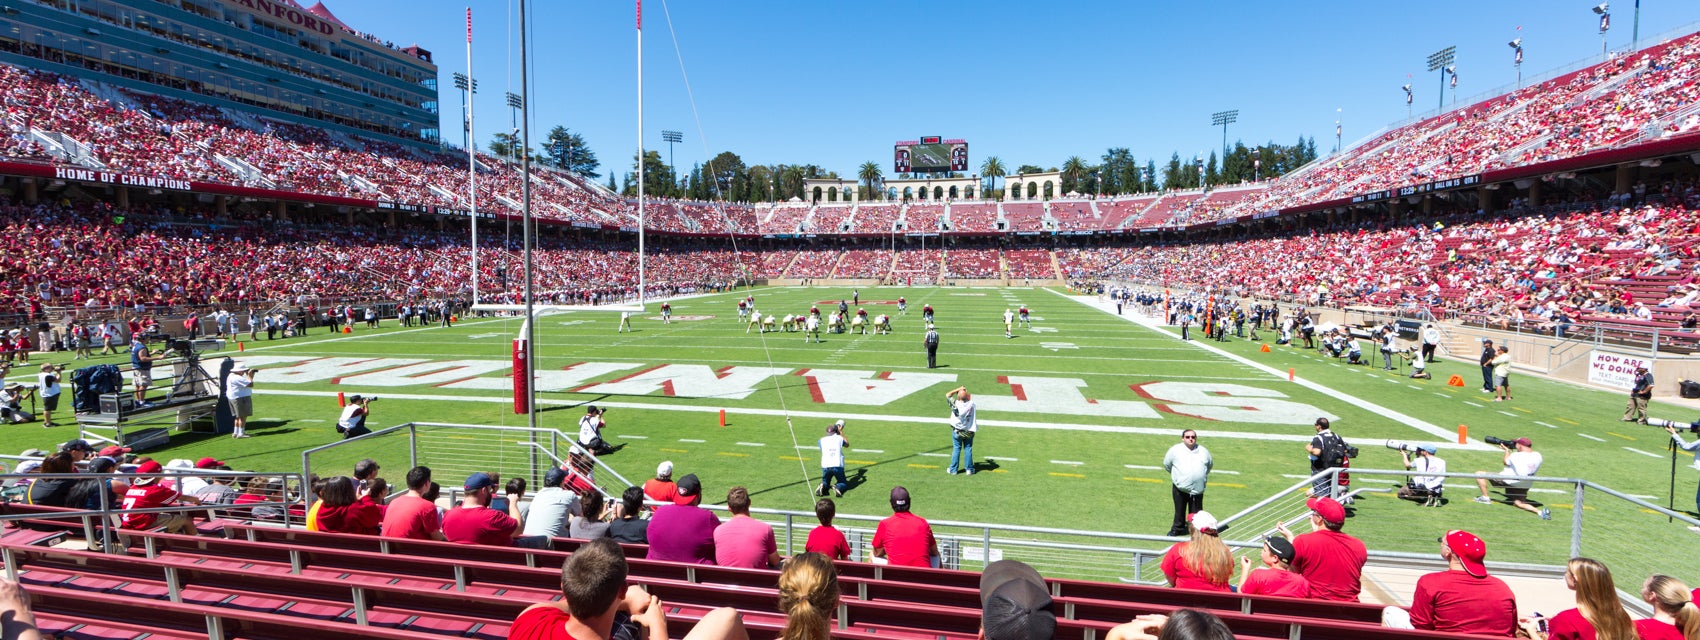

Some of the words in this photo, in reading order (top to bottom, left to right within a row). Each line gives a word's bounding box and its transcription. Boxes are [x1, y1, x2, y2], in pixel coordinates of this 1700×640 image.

[232, 0, 334, 35] ANFORD
[56, 168, 96, 182] HOME
[100, 172, 115, 183] OF
[122, 174, 191, 190] CHAMPIONS
[1598, 354, 1620, 363] HOW
[1624, 358, 1644, 368] ARE
